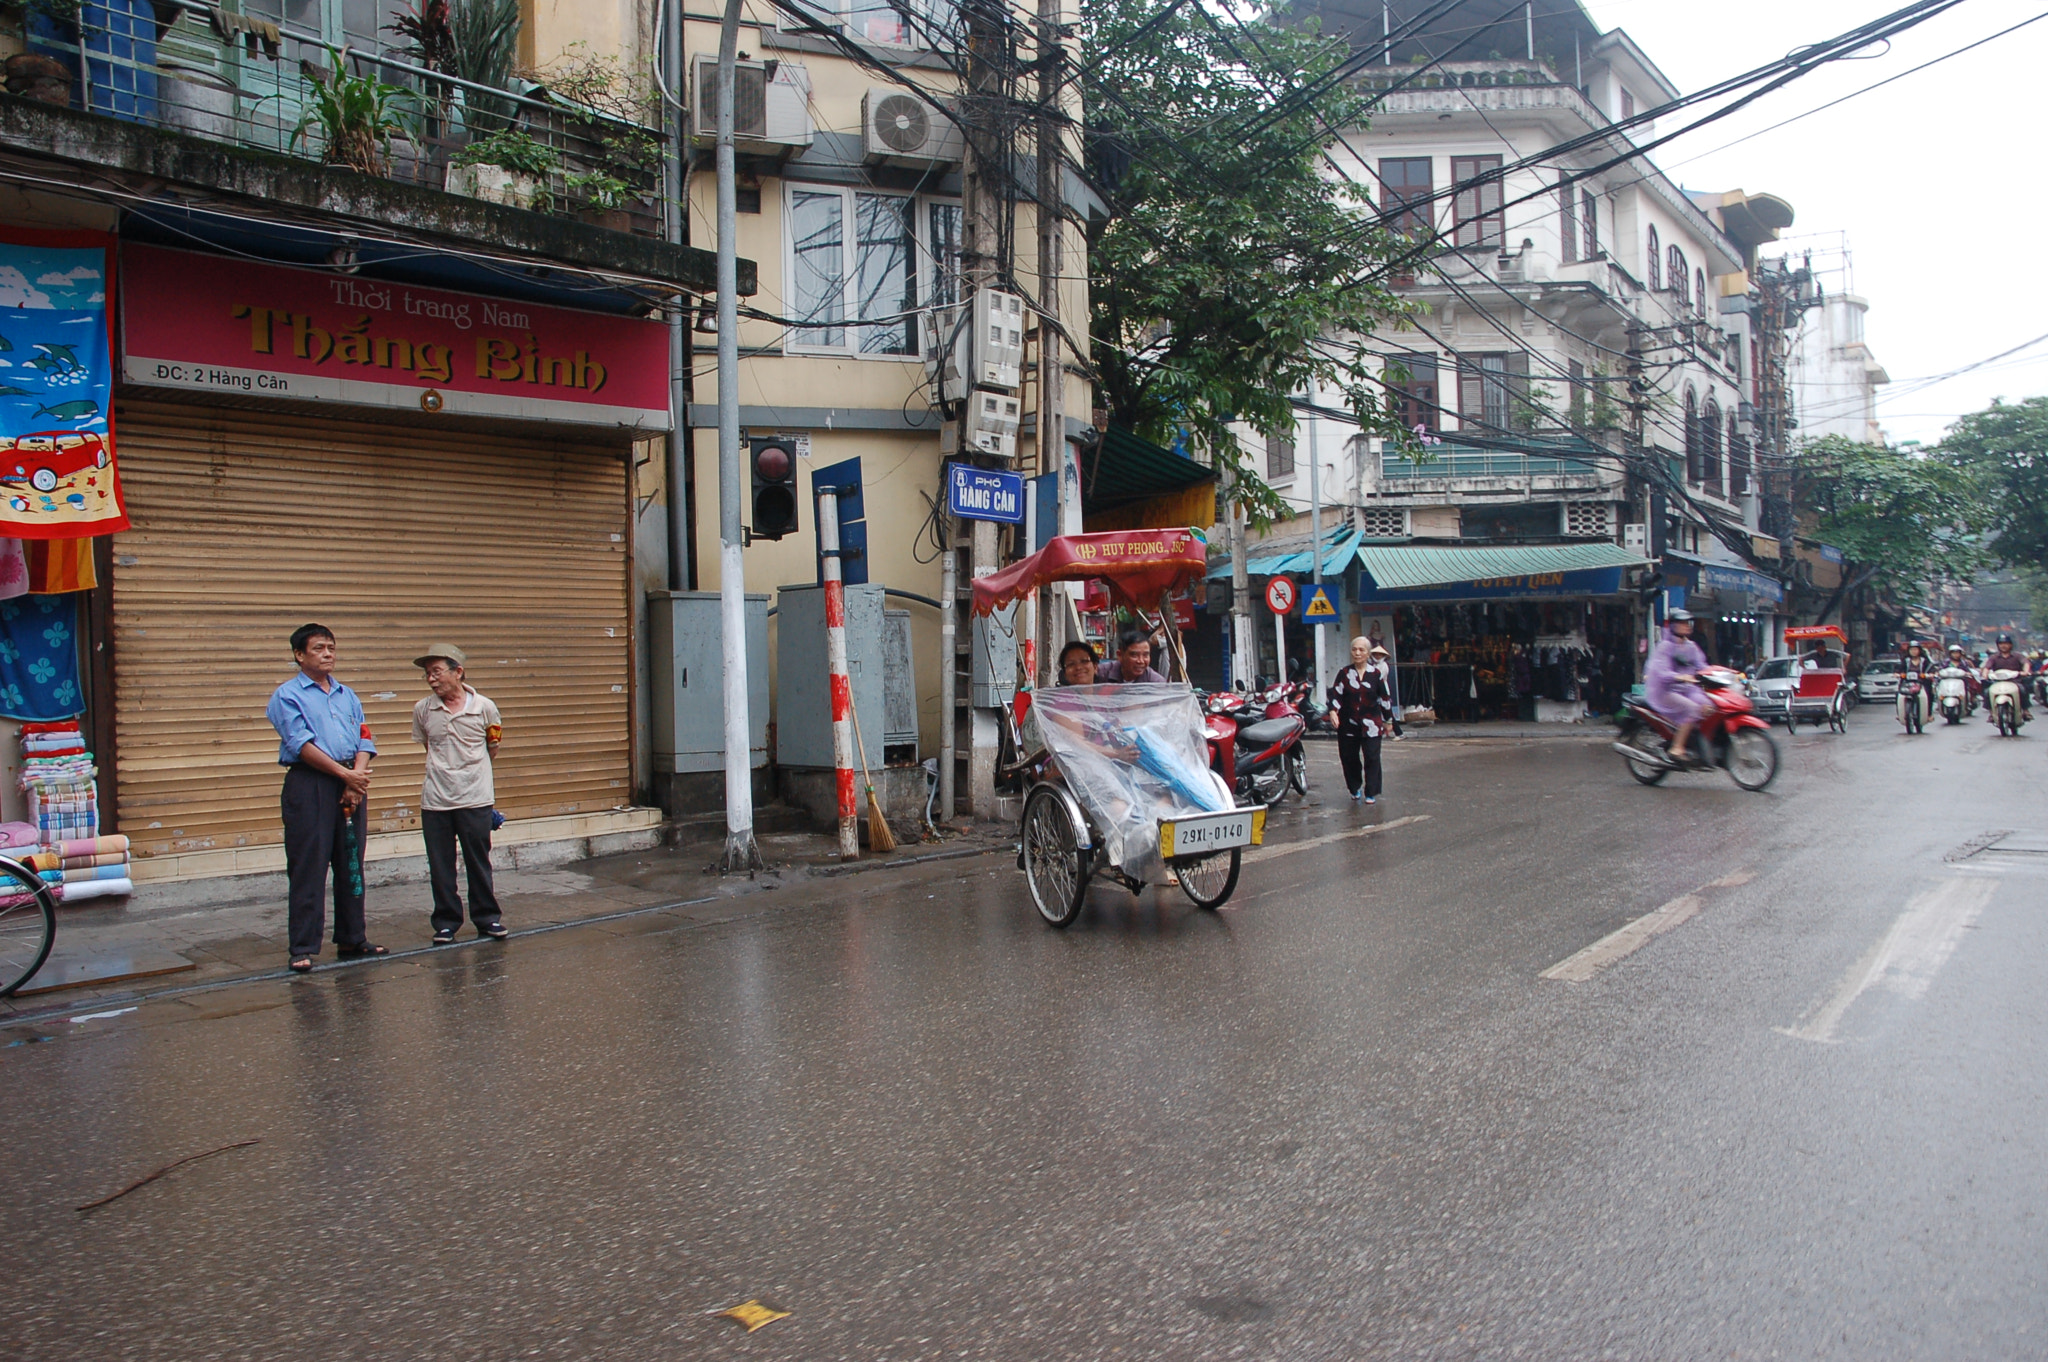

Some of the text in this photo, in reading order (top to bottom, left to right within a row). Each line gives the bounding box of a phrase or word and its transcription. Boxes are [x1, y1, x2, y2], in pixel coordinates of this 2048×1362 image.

[330, 280, 531, 330] Thời trang Nam
[231, 303, 607, 394] Thắng Bình
[157, 364, 288, 390] ĐC: 2 Hàng Cân
[959, 485, 1016, 513] HÀNG CÂN
[1102, 543, 1125, 556] HUY
[1171, 540, 1185, 553] JSC
[1182, 823, 1243, 845] 29XL-0140
